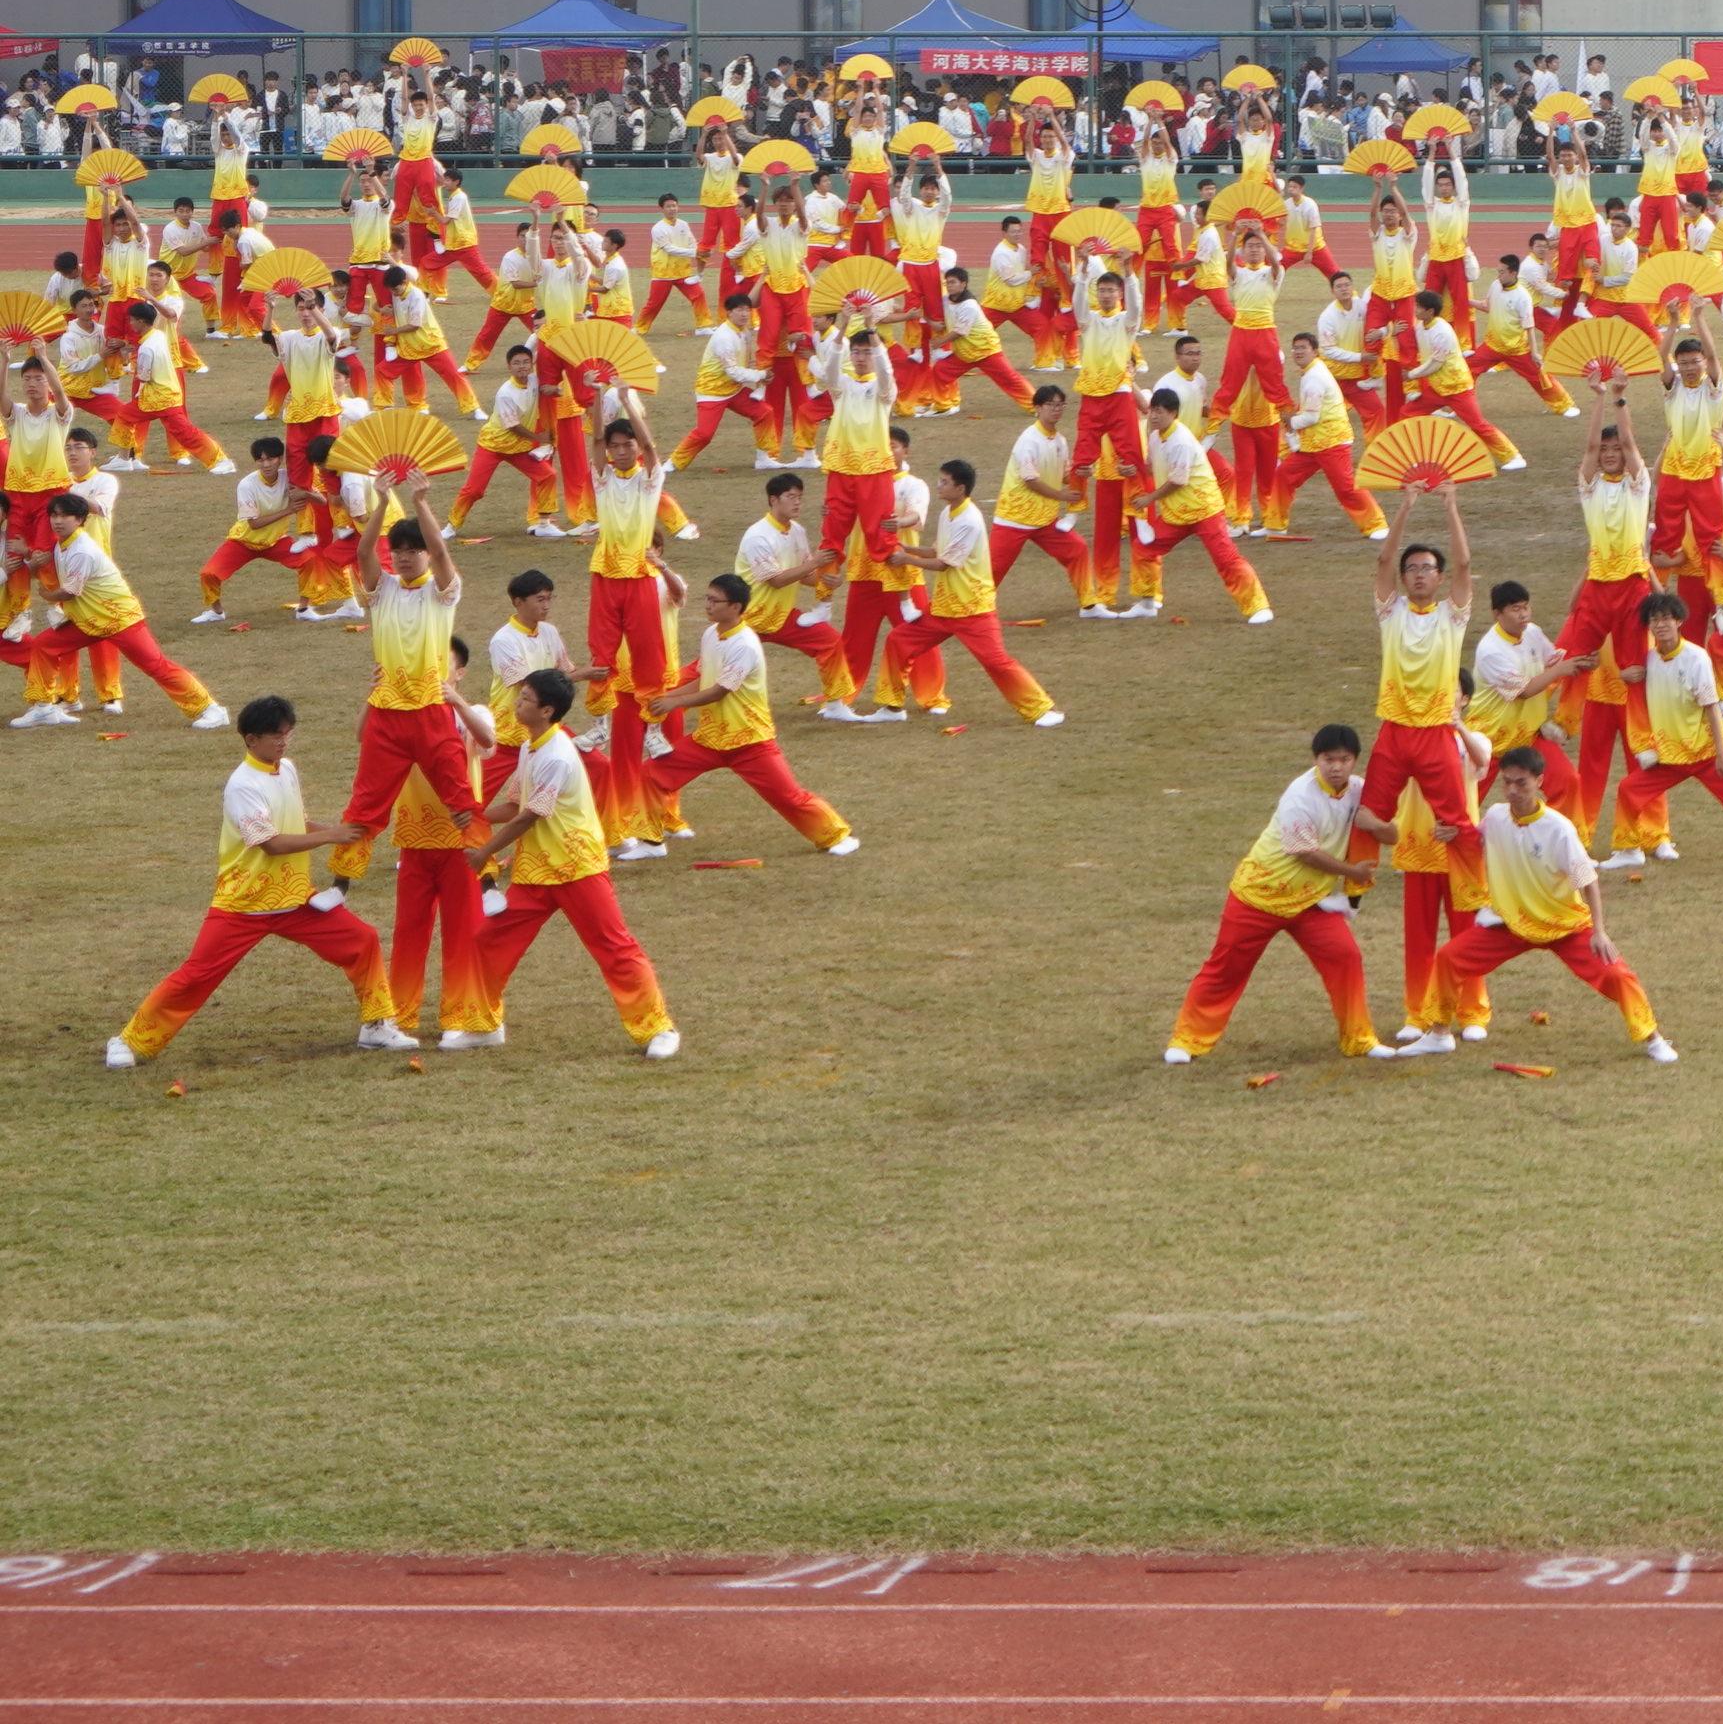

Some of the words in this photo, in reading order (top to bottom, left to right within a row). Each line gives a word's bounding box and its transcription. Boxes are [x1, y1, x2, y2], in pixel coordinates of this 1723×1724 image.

[932, 53, 1089, 73] 河海大学海洋学院
[1522, 1551, 1696, 1596] 118
